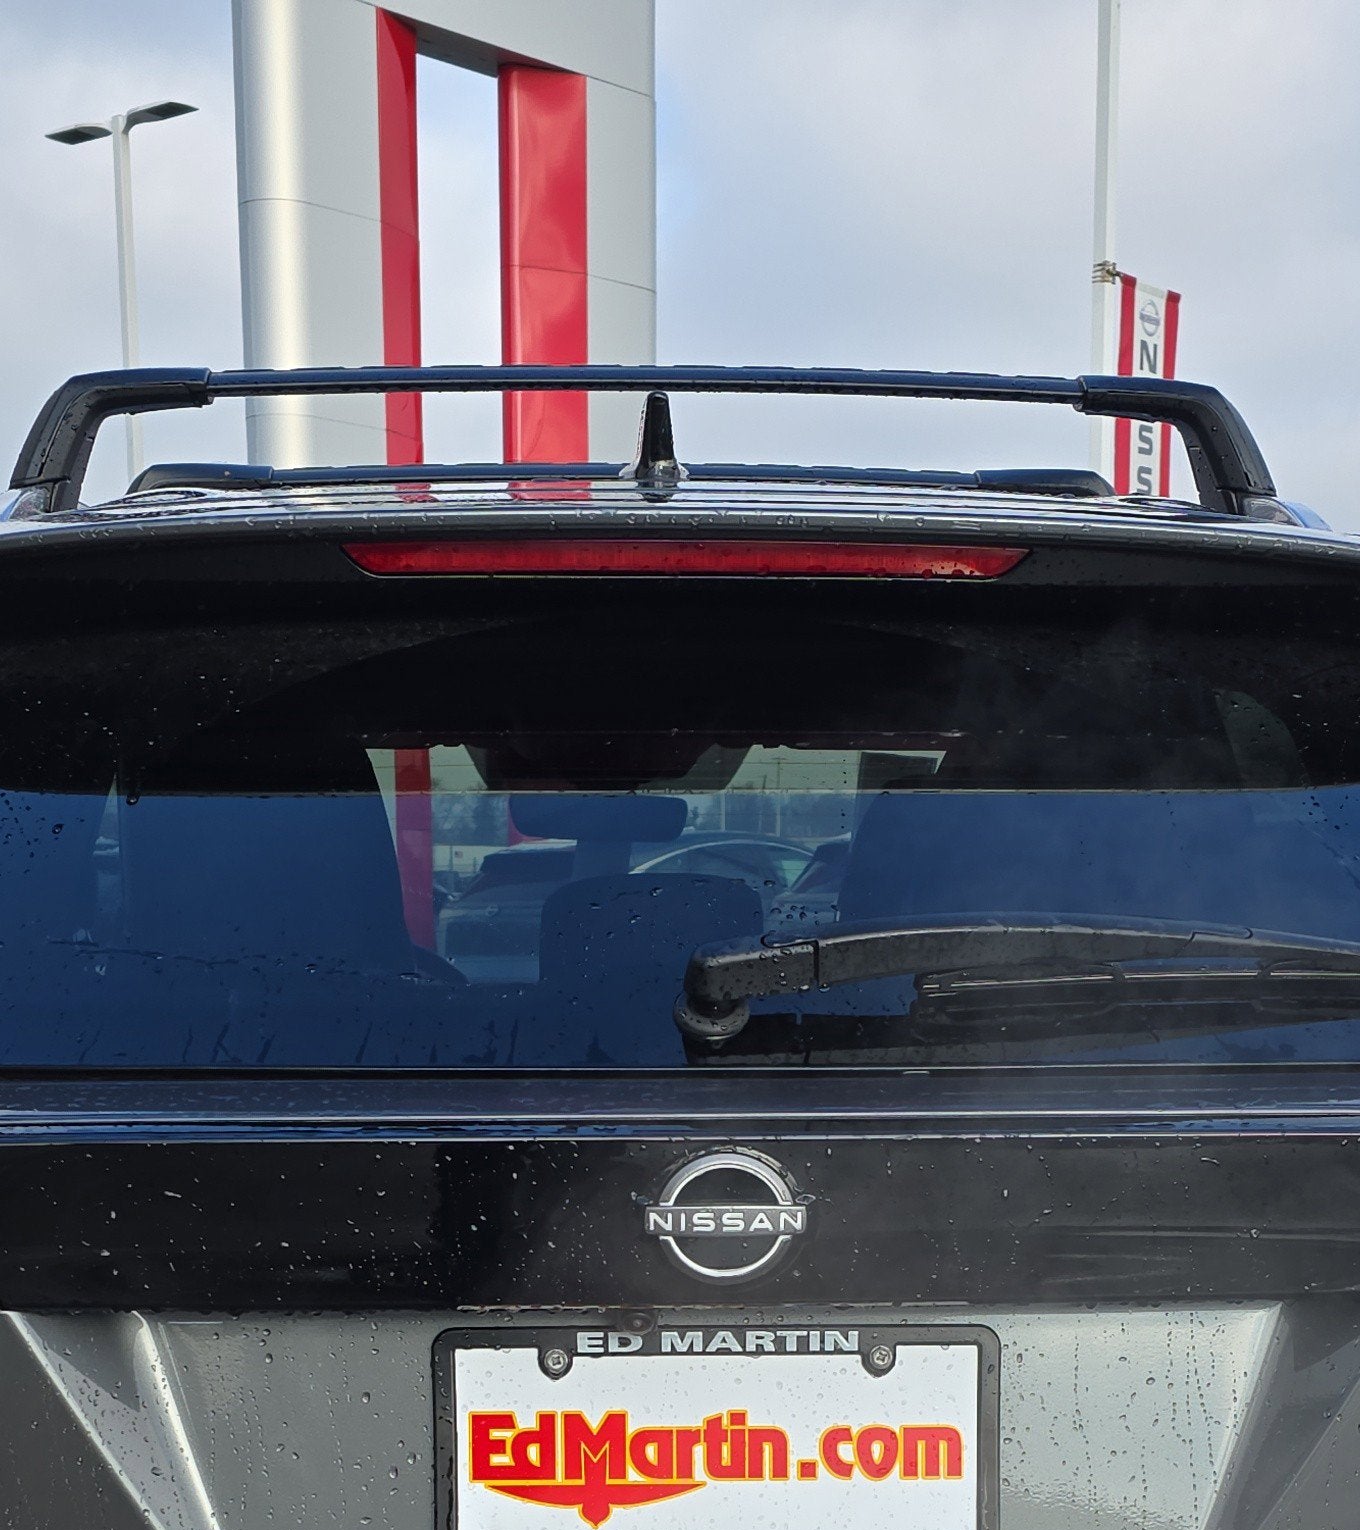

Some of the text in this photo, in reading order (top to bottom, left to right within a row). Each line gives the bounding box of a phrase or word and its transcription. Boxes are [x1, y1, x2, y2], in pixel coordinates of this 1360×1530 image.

[648, 1211, 803, 1233] NISSAN
[576, 1330, 860, 1353] ED MARTIN
[467, 1408, 965, 1486] EdMartin.com
